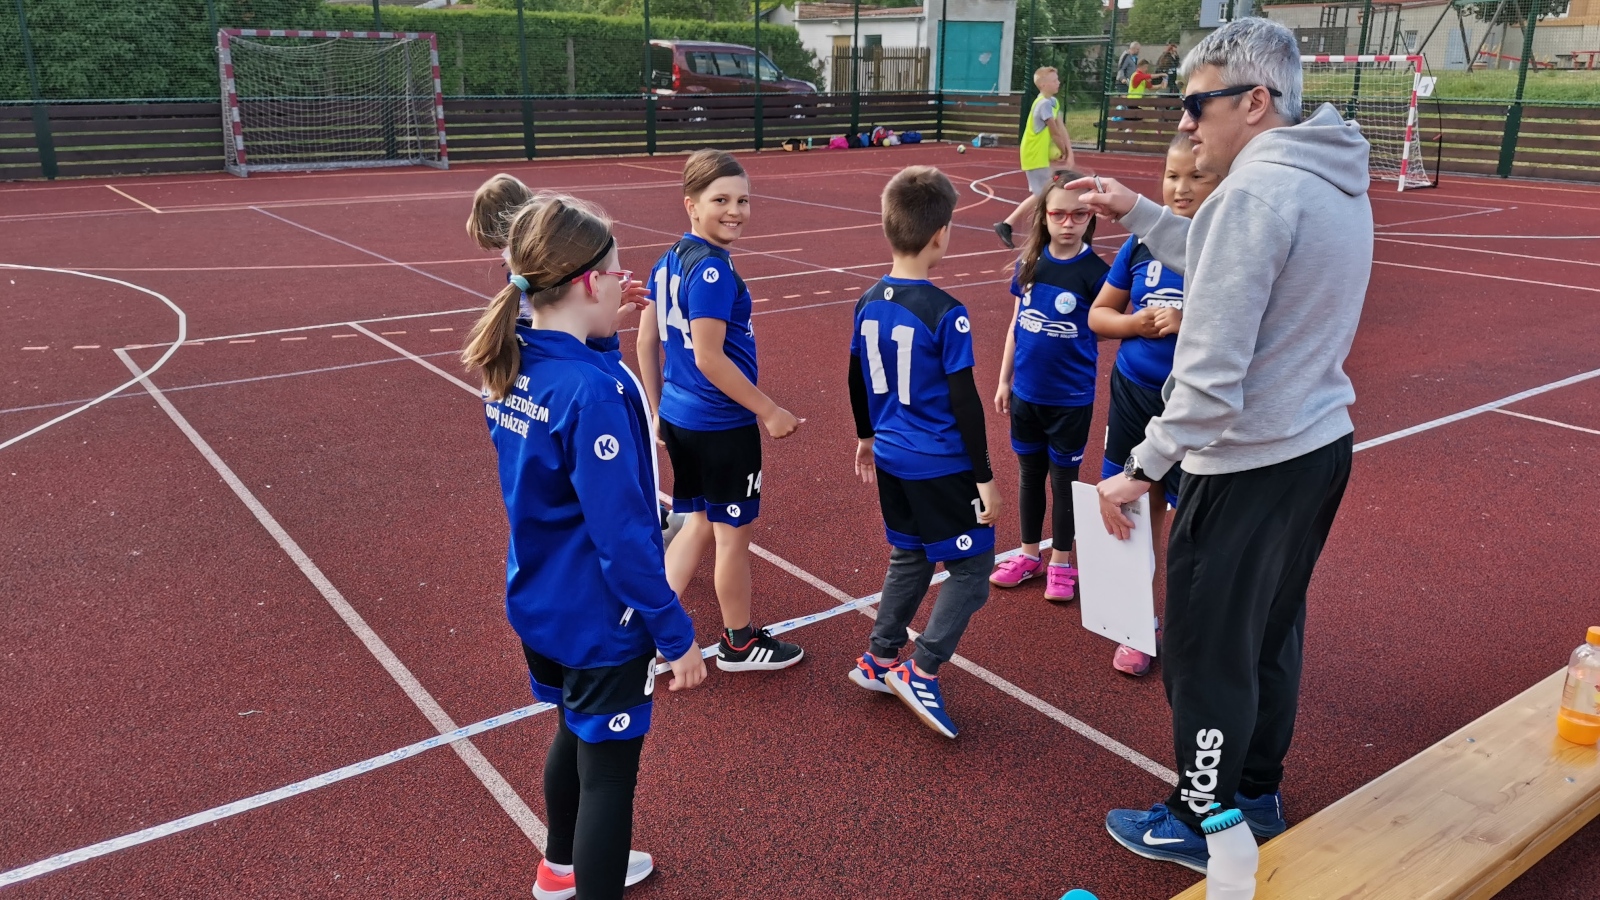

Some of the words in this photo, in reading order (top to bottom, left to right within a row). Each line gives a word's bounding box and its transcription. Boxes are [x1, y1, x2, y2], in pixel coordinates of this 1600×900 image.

[1145, 260, 1162, 288] 9
[861, 319, 915, 406] 11
[514, 374, 531, 392] KOL
[746, 469, 762, 498] 14
[970, 498, 986, 524] 1
[1180, 728, 1224, 818] didas
